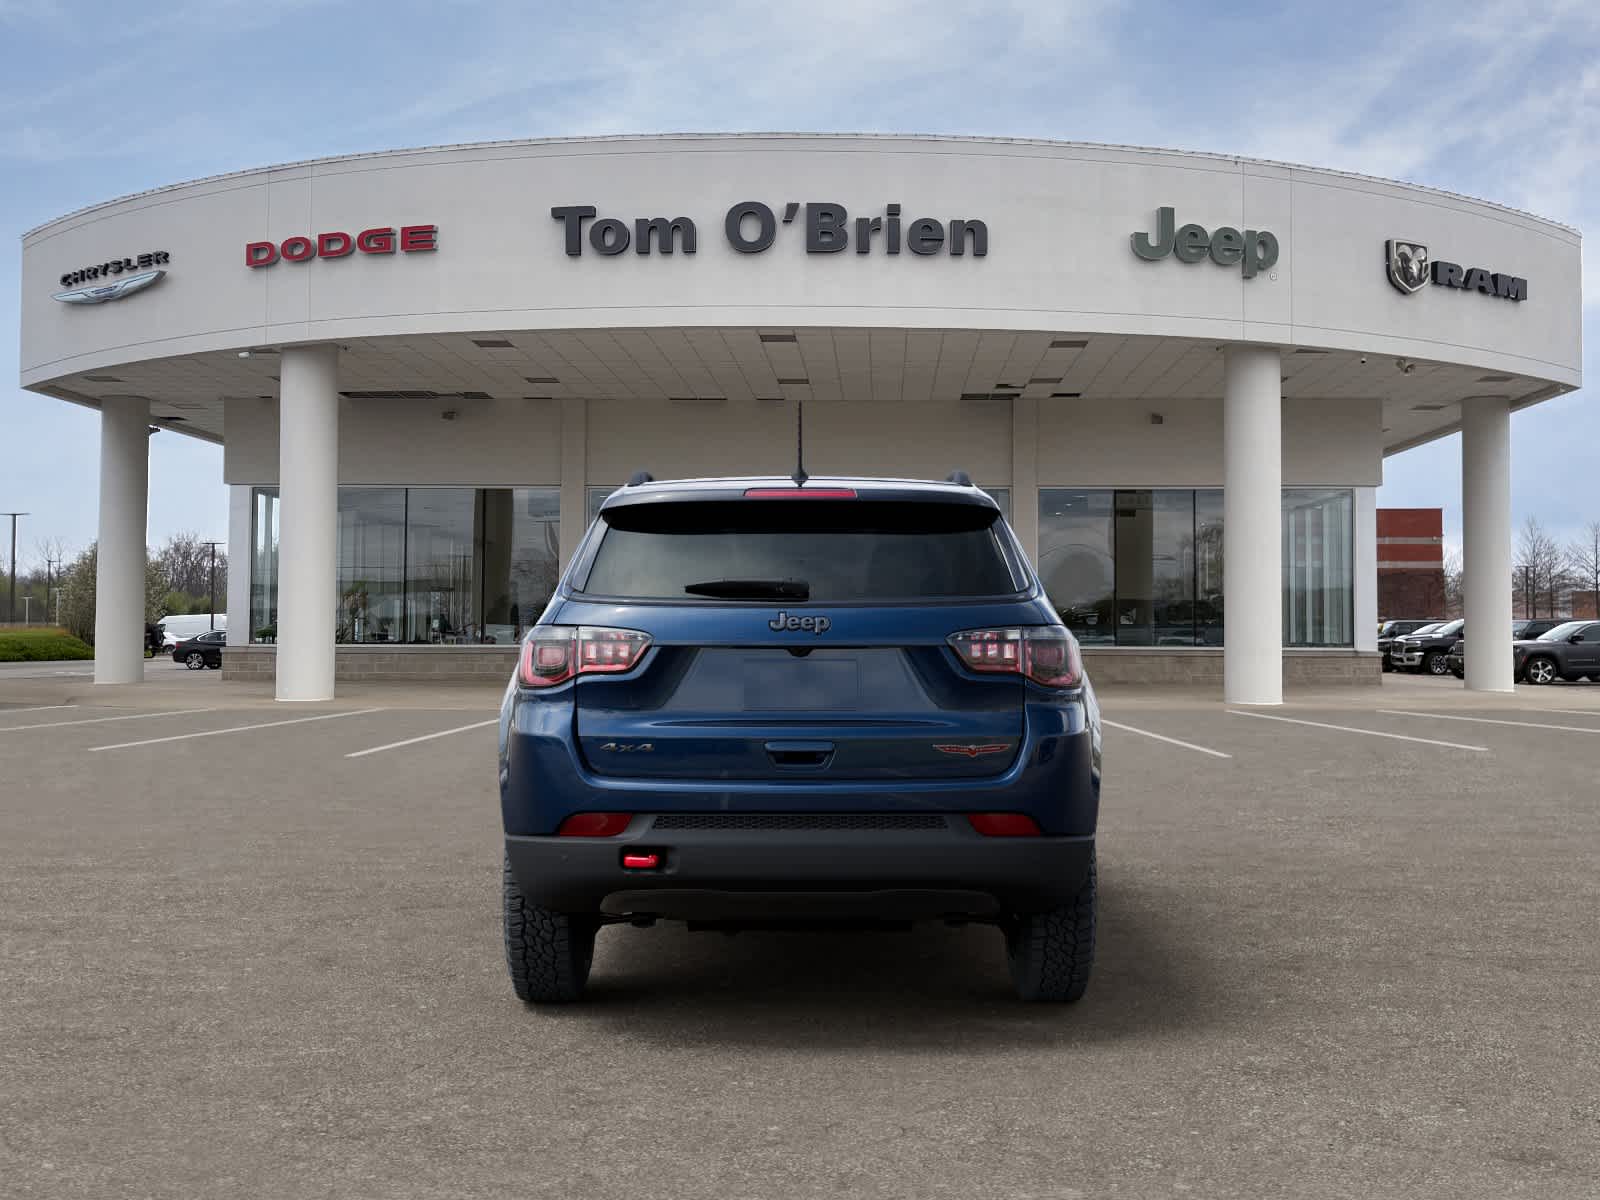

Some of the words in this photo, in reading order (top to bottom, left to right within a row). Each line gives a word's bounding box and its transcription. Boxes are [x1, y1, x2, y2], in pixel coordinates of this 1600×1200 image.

[245, 224, 438, 268] DODGE
[551, 205, 697, 257] Tom
[725, 200, 989, 257] O'Brien
[1130, 206, 1280, 280] Jeep
[60, 250, 170, 287] CHRYSLER
[1430, 260, 1528, 302] RAM
[768, 611, 832, 636] Jeep
